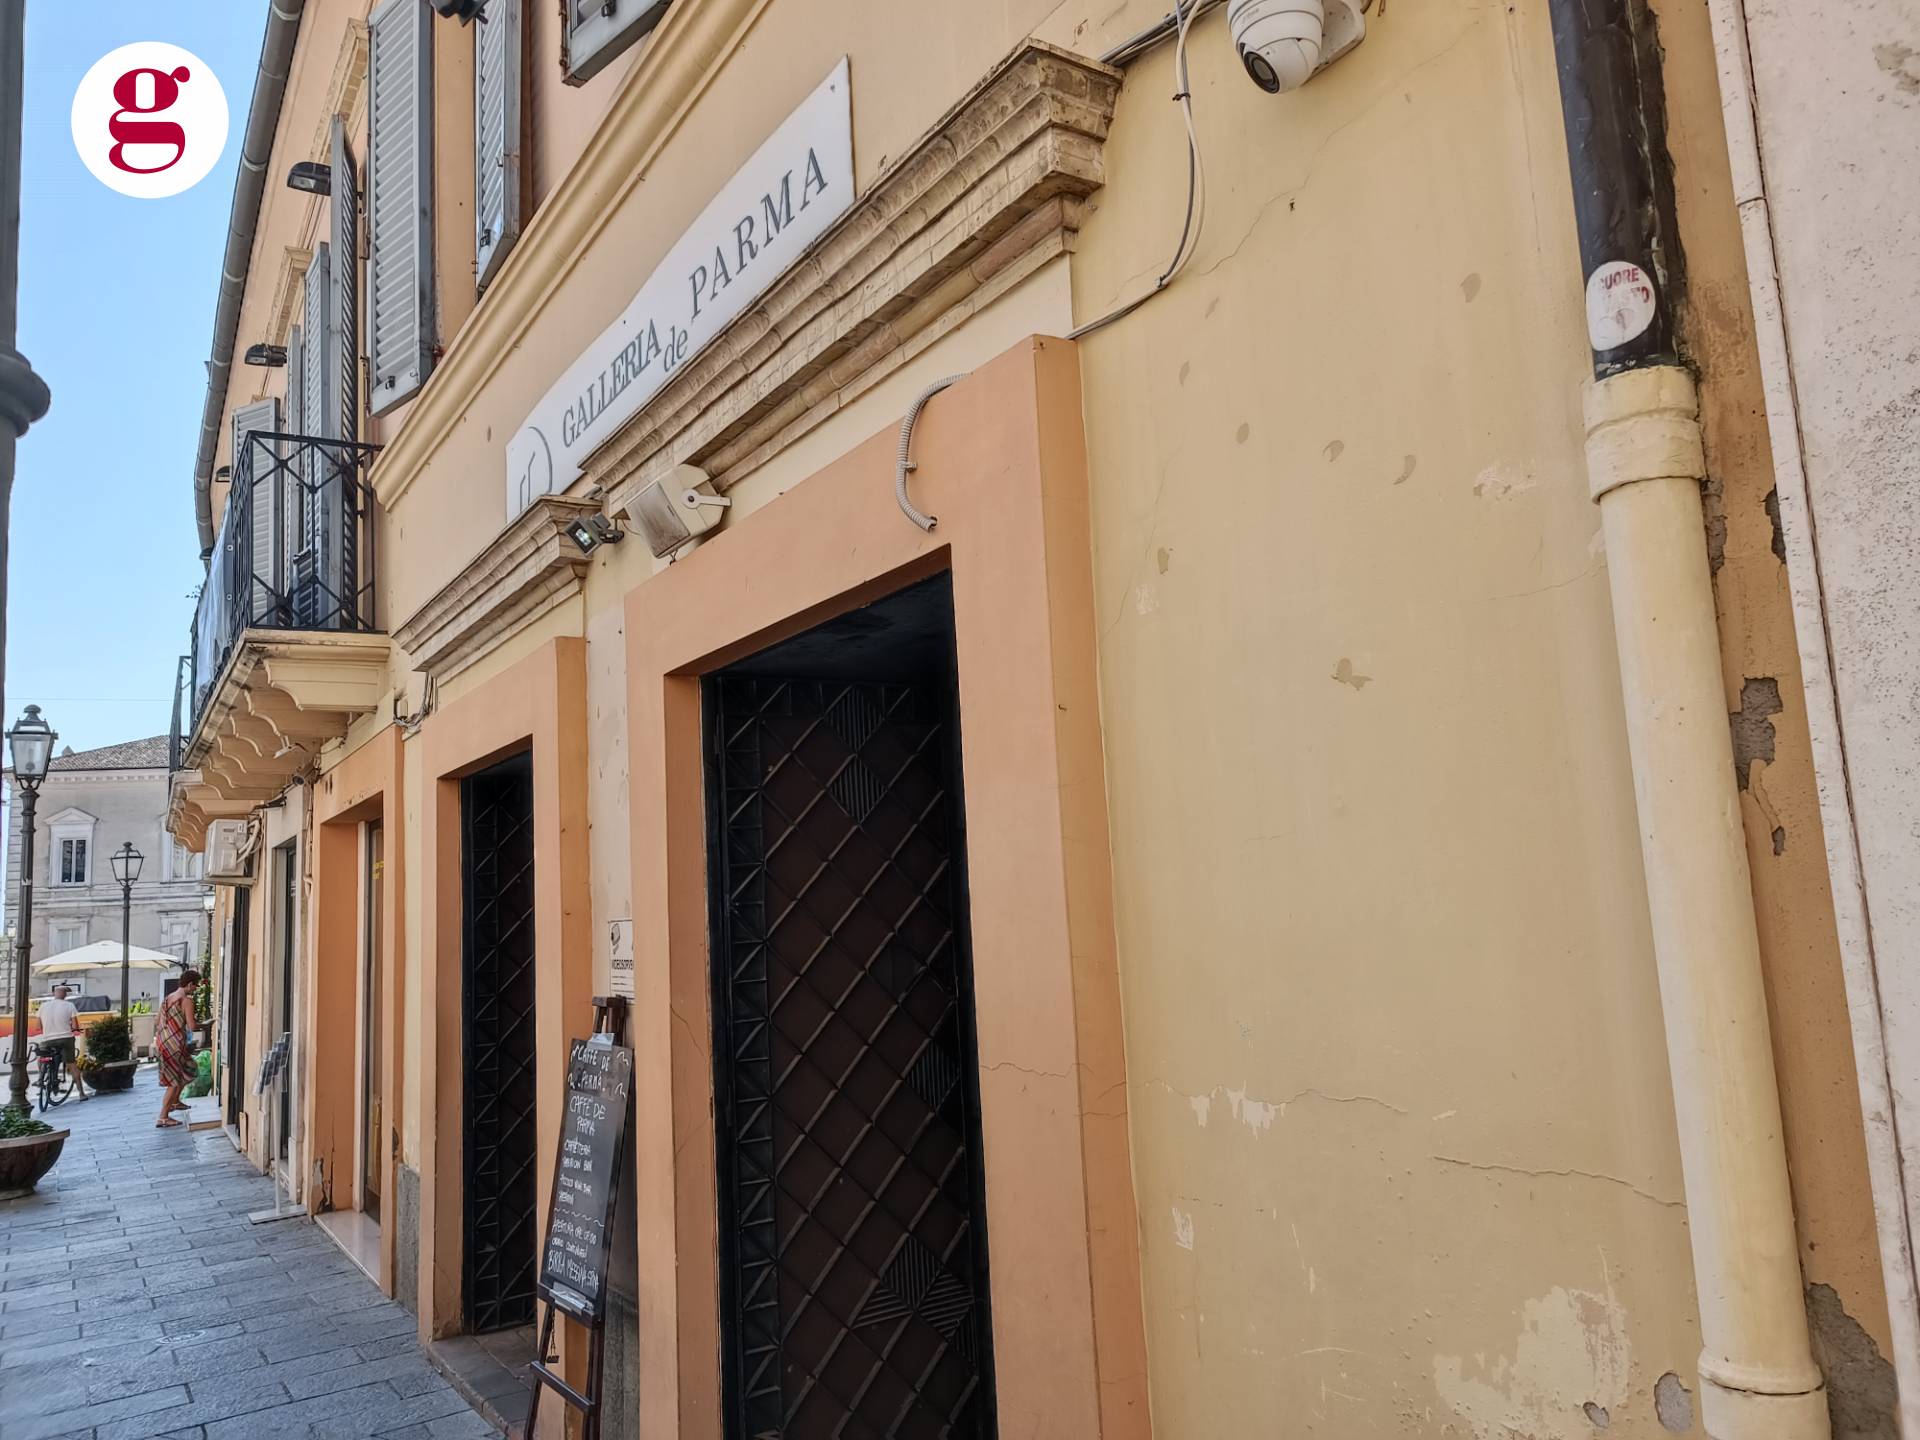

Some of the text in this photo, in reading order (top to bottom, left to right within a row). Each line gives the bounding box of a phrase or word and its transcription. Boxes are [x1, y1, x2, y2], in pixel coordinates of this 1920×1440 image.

[562, 146, 829, 448] GALLERIA de PARMA
